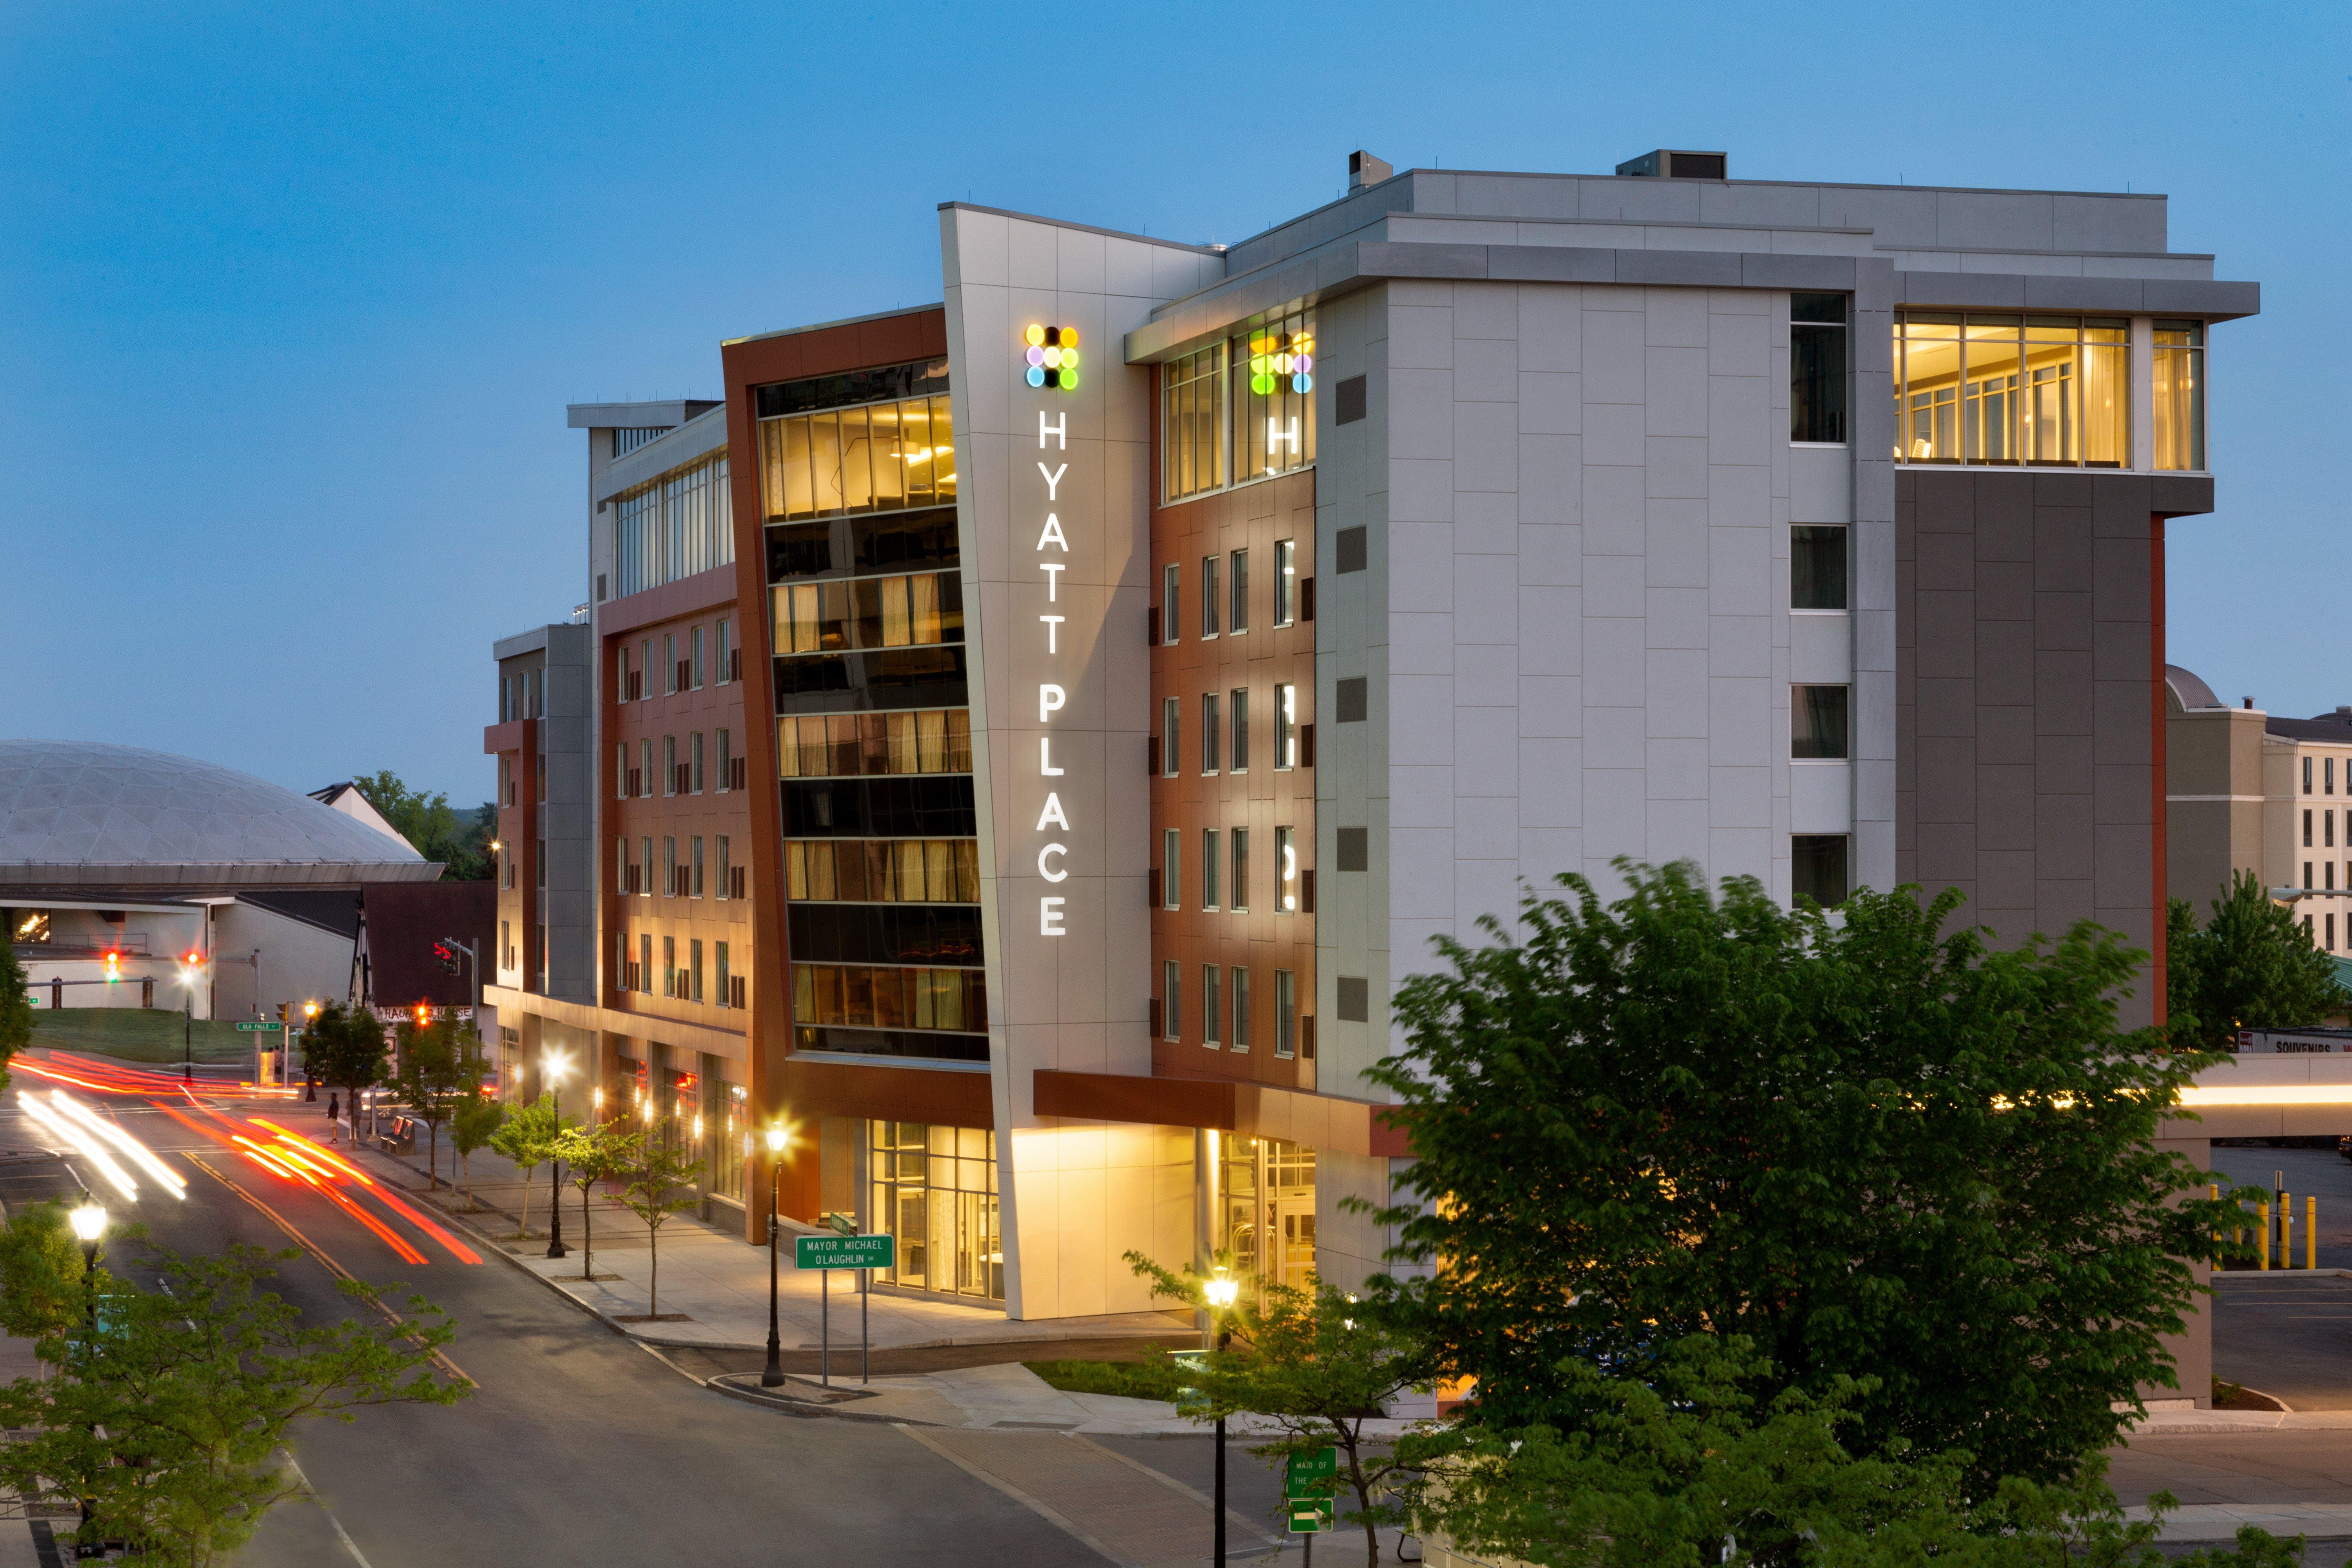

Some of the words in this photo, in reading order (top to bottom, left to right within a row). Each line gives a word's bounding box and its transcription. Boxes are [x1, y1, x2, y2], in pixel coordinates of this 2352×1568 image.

[1037, 411, 1069, 654] HYATT
[1036, 684, 1069, 936] PLACE
[437, 1007, 471, 1019] HSE
[807, 1241, 837, 1251] MAYOR
[845, 1240, 882, 1250] MICHAEL
[816, 1254, 864, 1265] O'LAUGHLIN
